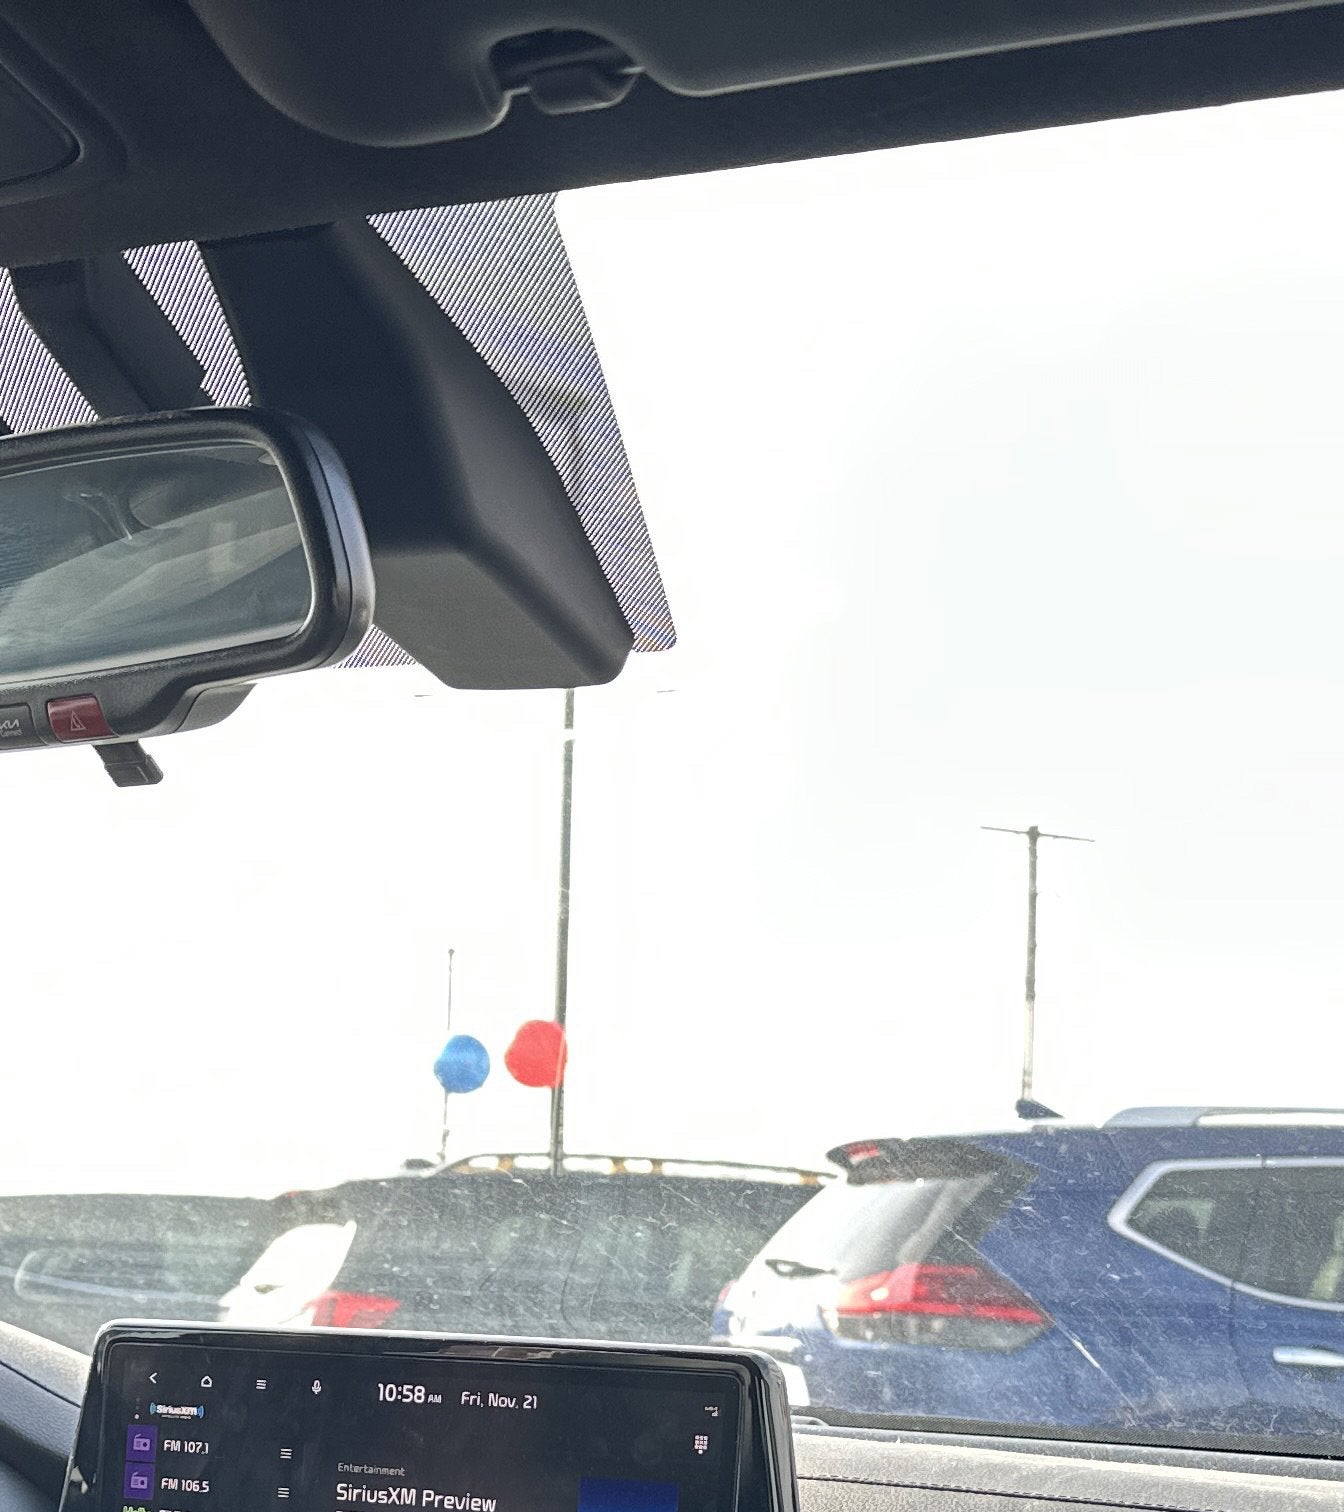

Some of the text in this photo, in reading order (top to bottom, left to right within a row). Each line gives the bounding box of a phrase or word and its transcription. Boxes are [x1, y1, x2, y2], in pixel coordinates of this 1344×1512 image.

[377, 1383, 426, 1403] 10:58
[427, 1394, 442, 1404] AM
[461, 1391, 484, 1408] Fri,
[523, 1395, 538, 1409] 21
[163, 1440, 209, 1455] FM 107.1
[337, 1462, 405, 1477] Entertainment
[161, 1478, 210, 1493] FM 106.5
[336, 1483, 497, 1512] SiriusXM Preview
